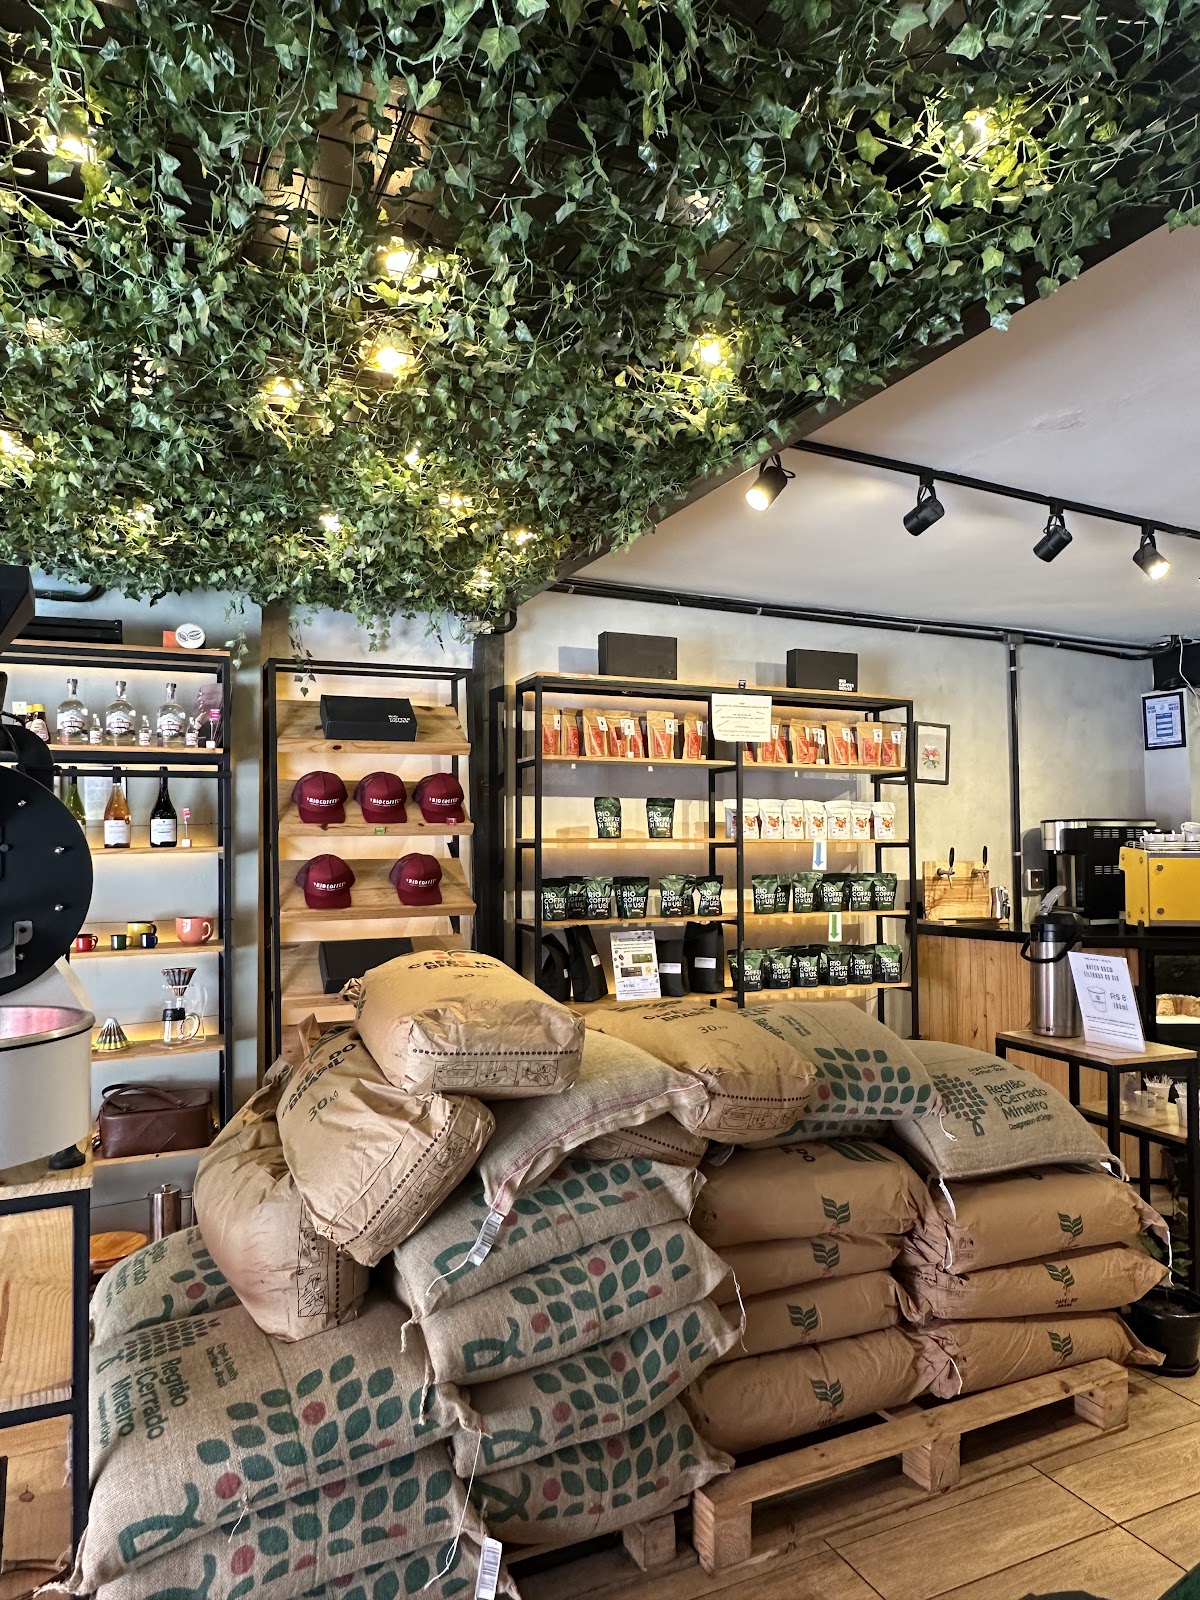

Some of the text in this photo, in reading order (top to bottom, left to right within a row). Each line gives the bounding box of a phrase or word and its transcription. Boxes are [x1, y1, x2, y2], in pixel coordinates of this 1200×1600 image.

[1001, 1087, 1048, 1104] Cerrado
[1001, 1100, 1048, 1120] Mineiro
[110, 1374, 136, 1436] Mineiro
[136, 1372, 168, 1440] Cerrado
[160, 1357, 190, 1407] Região
